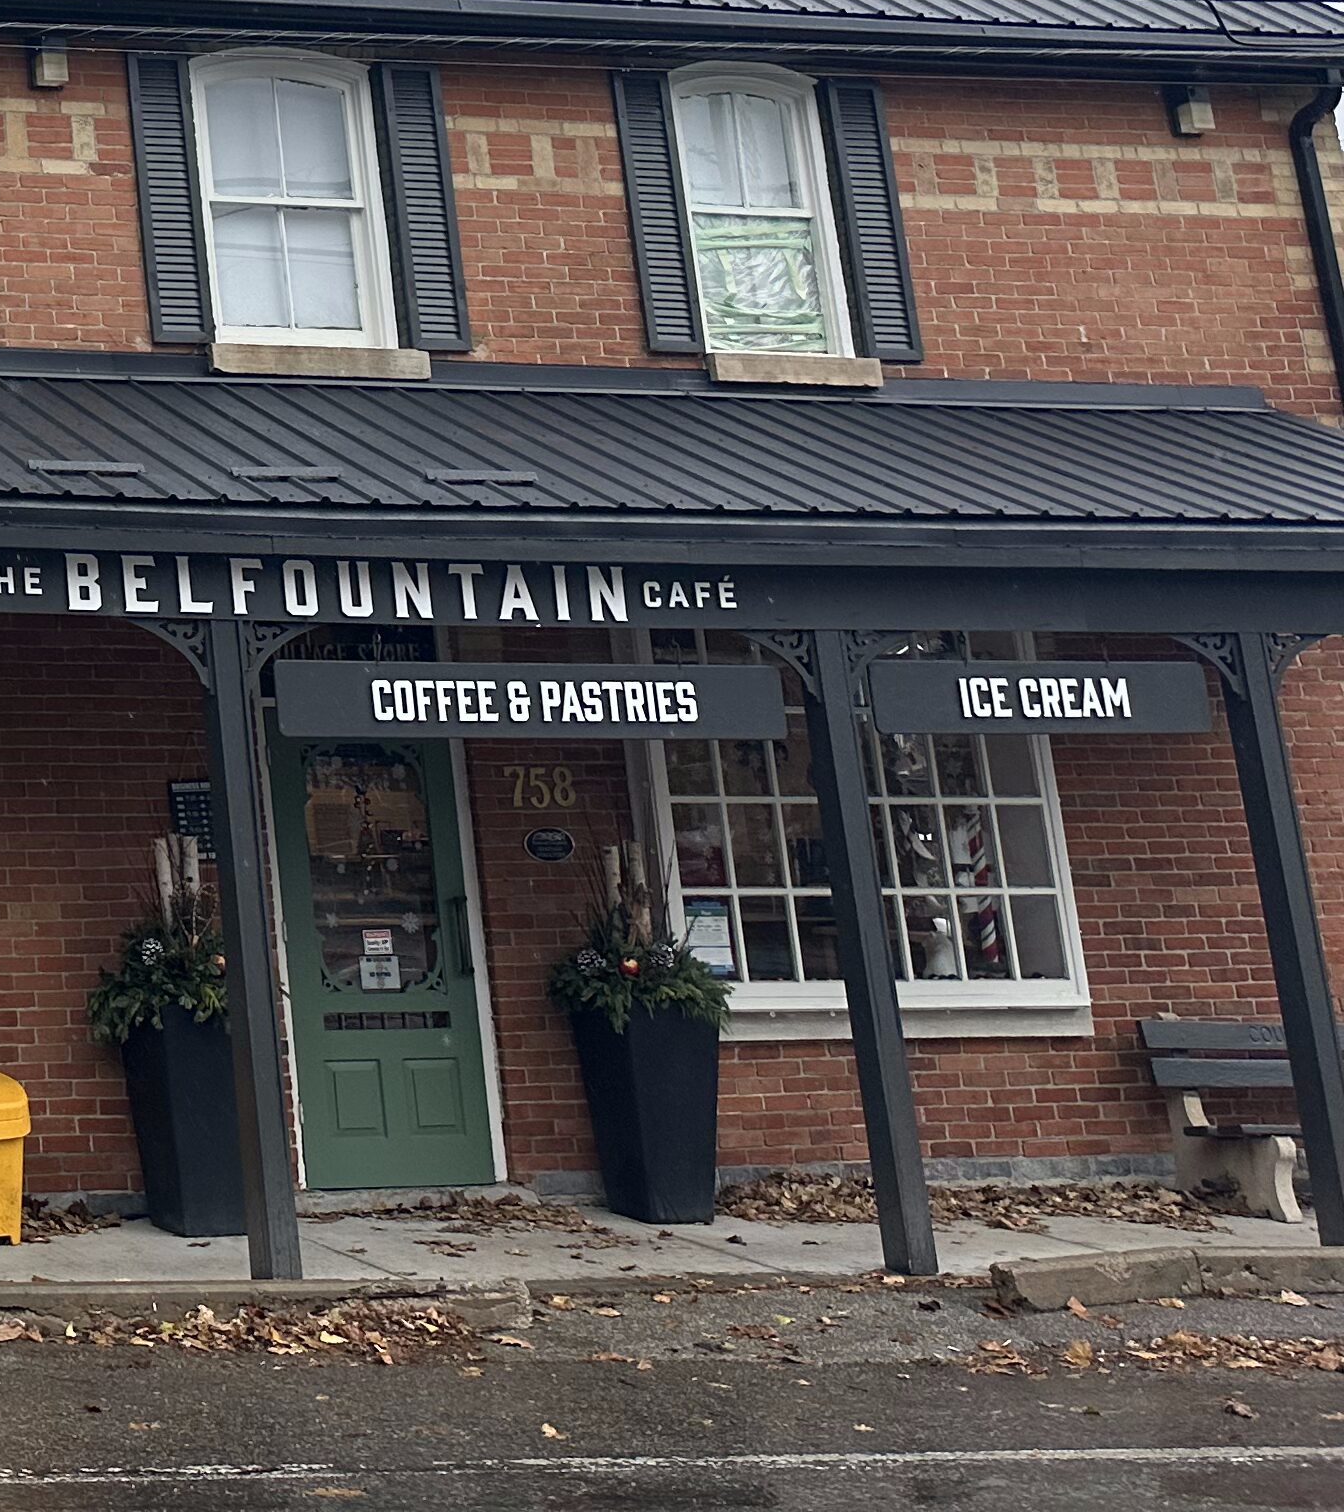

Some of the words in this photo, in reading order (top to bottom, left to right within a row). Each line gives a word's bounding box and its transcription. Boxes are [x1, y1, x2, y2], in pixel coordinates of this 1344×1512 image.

[64, 552, 629, 622] BELFOUNTAIN
[643, 575, 738, 609] CAFÉ
[371, 679, 499, 721] COFFEE
[507, 680, 531, 721] &
[539, 681, 698, 722] PASTRIES
[958, 677, 1013, 718] ICE
[1018, 677, 1132, 718] CREAM
[503, 766, 577, 808] 758
